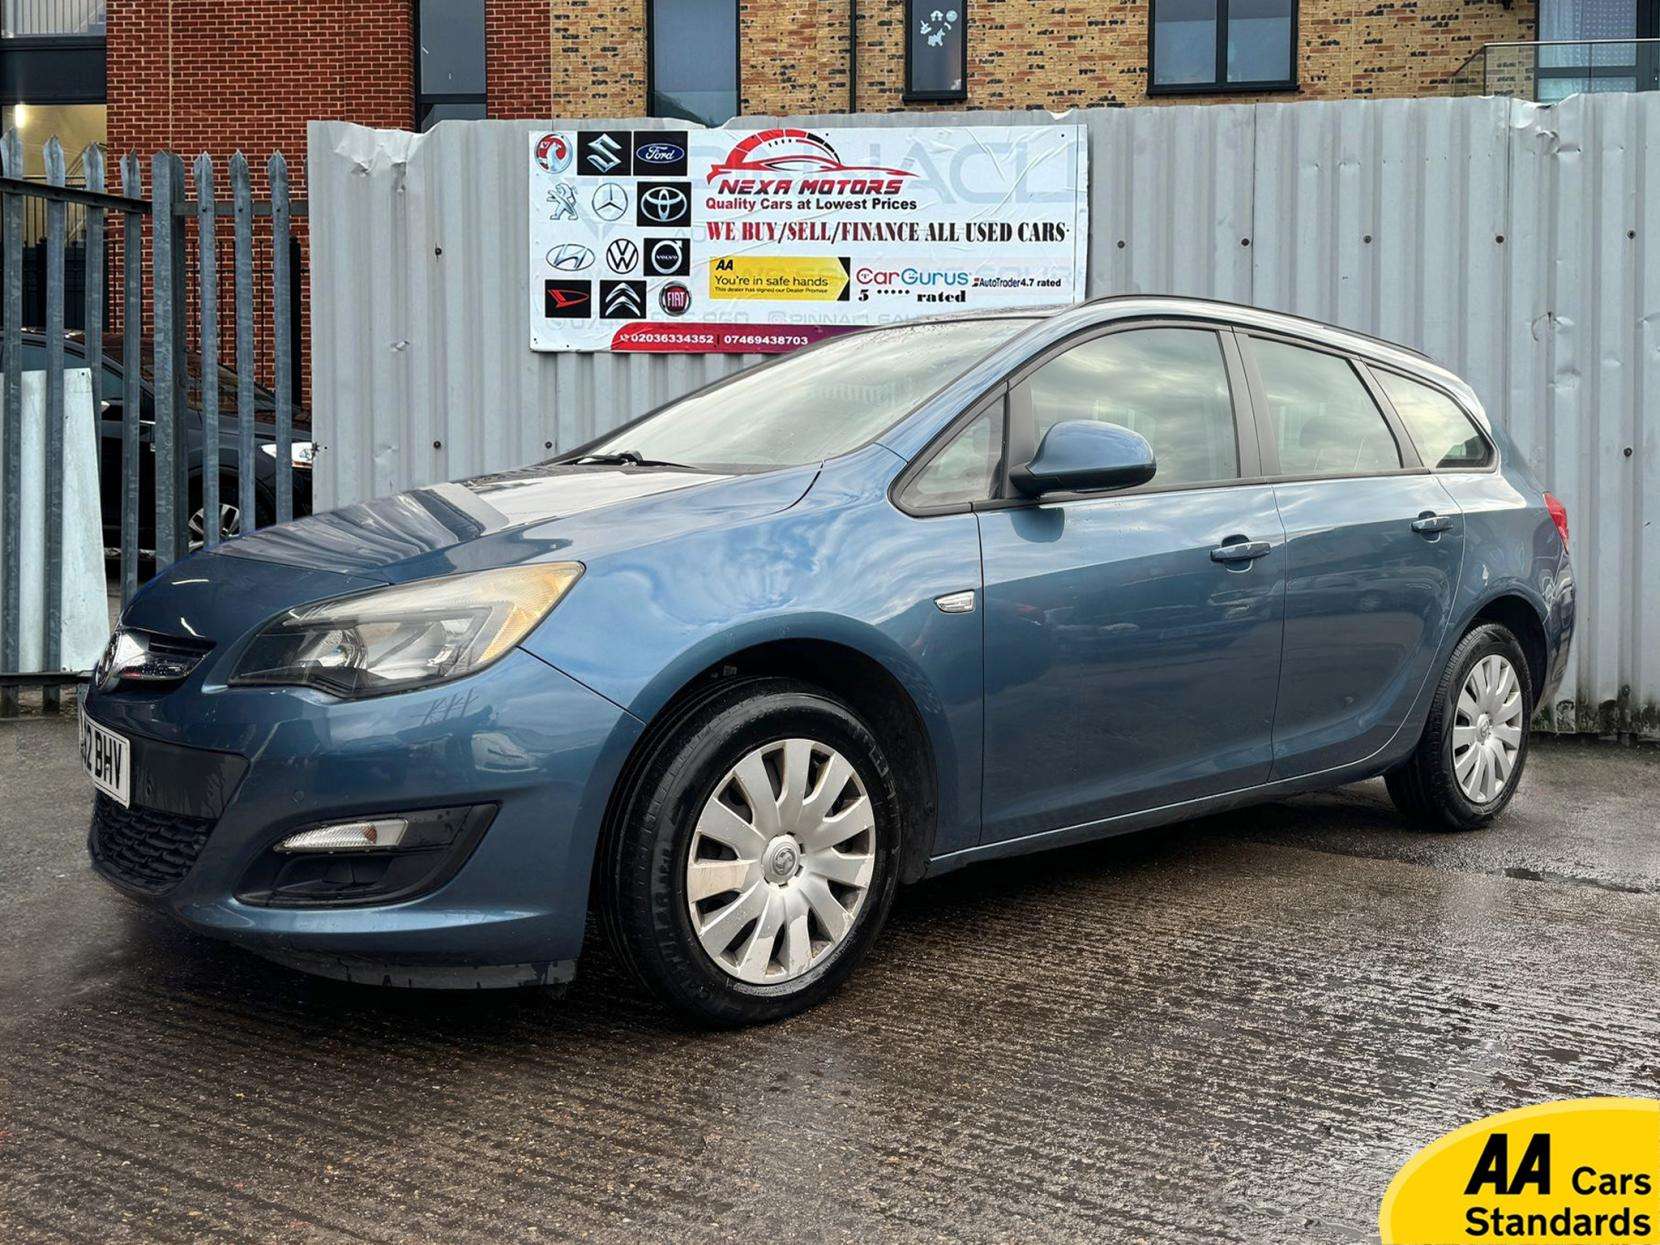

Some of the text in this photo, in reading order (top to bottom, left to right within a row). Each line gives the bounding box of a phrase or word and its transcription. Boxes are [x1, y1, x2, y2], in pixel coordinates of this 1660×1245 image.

[645, 145, 675, 160] Ford
[717, 179, 903, 195] NEXA MOTORS
[705, 197, 917, 212] Quality Cars at Lowest Prices
[706, 221, 735, 241] WE
[925, 222, 960, 242] ALL
[965, 222, 1013, 242] USED
[1018, 222, 1066, 242] CARS
[715, 259, 734, 271] AA
[714, 275, 829, 287] You're in safe hands
[856, 268, 969, 285] CarGurus
[1037, 278, 1062, 287] rated
[667, 291, 686, 307] FIAT
[917, 290, 967, 302] rated
[631, 334, 809, 345] 02036334352 07469438703
